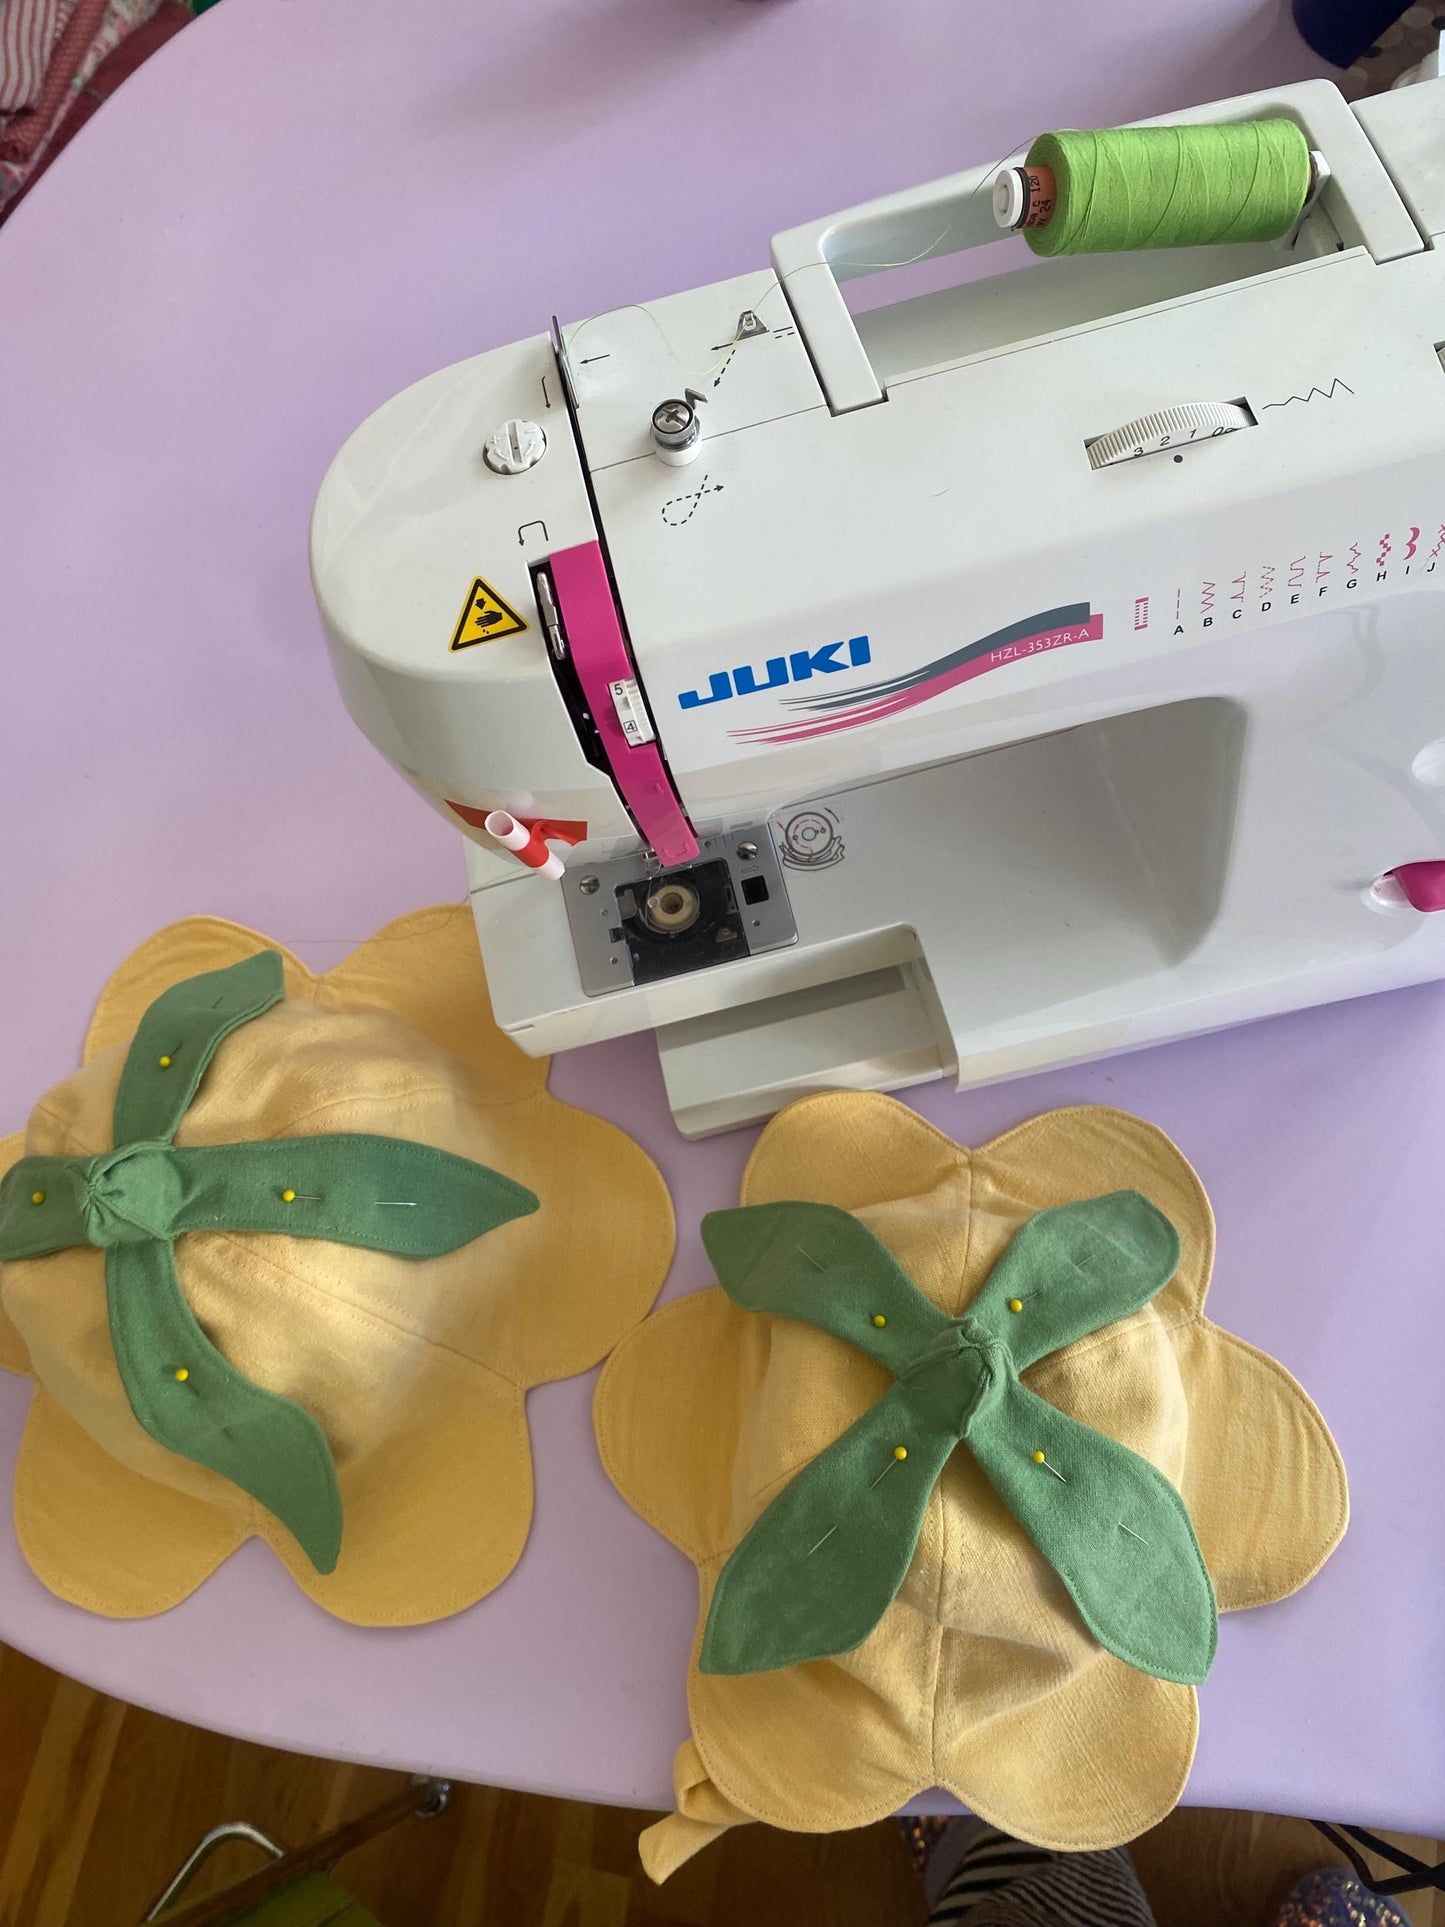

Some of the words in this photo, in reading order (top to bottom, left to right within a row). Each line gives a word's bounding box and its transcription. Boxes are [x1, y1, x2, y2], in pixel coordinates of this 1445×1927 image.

[1030, 175, 1041, 193] 120
[1133, 447, 1144, 457] 3
[1160, 436, 1171, 446] 2
[1189, 428, 1197, 439] 1
[1173, 625, 1185, 636] A
[1203, 617, 1213, 628] B
[1232, 609, 1242, 619] C
[1261, 602, 1272, 612] D
[1290, 594, 1300, 605] E
[1318, 586, 1328, 597] F
[1346, 579, 1357, 589] G
[1376, 571, 1387, 582] H
[1405, 565, 1410, 575] I
[1426, 562, 1436, 573] J
[990, 628, 1090, 662] HZL-353ZR-A
[678, 635, 871, 710] JUKI
[614, 683, 623, 696] 5
[627, 722, 635, 731] 4
